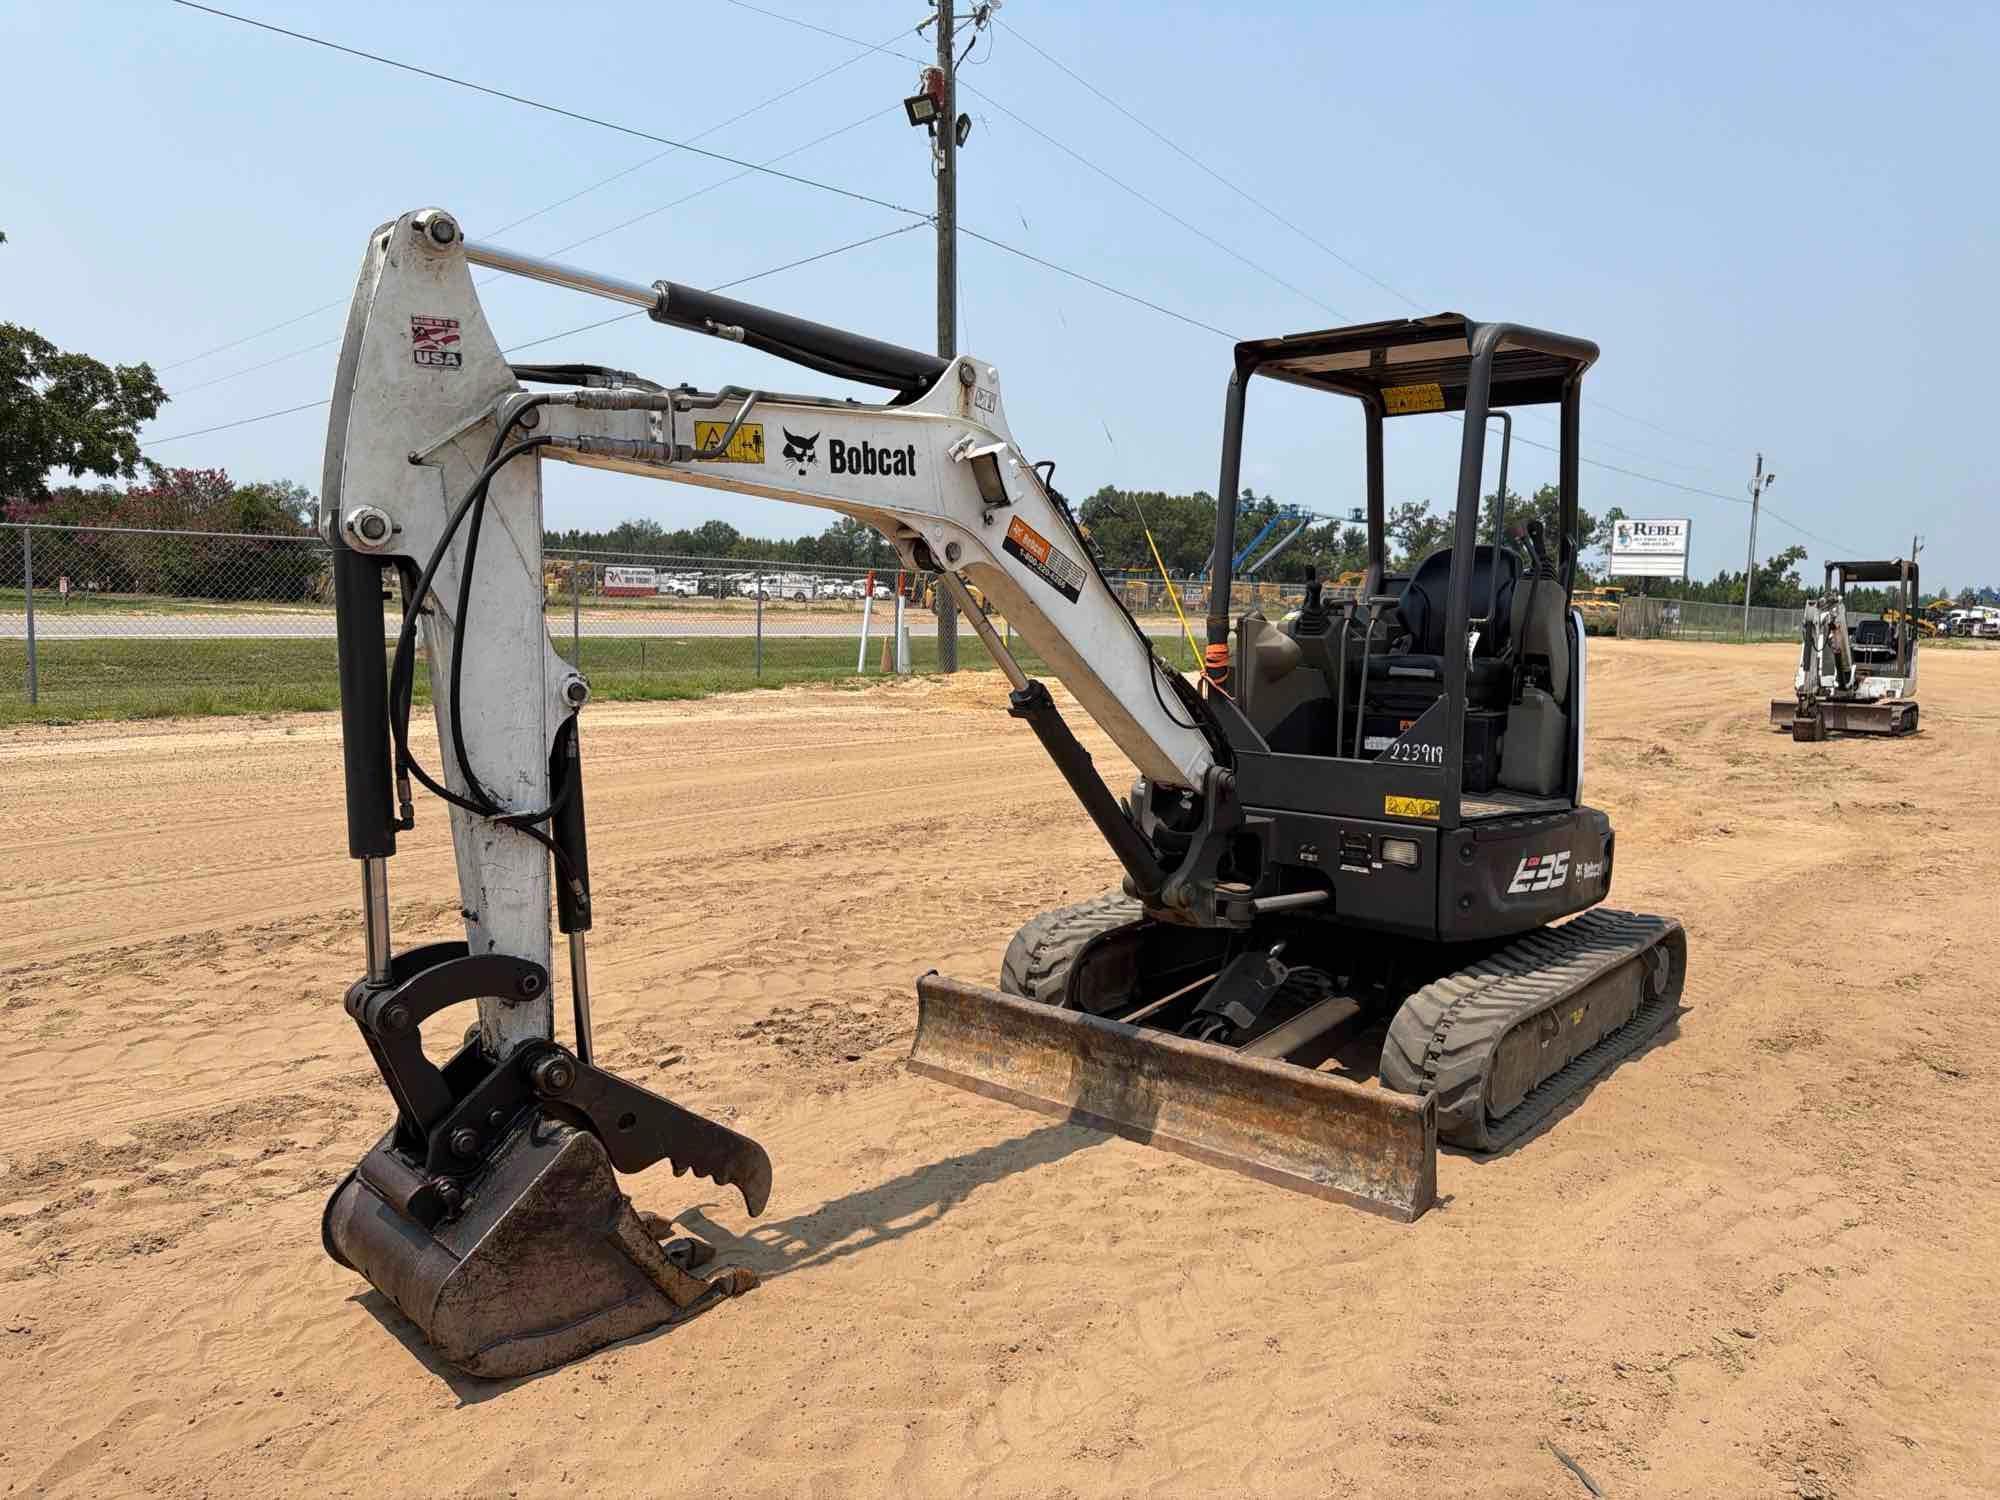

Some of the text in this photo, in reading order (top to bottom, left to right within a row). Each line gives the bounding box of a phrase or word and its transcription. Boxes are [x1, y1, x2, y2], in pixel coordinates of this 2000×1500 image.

[416, 351, 459, 365] USA
[829, 439, 916, 476] Bobcat
[1633, 522, 1683, 536] REBEL
[1390, 743, 1443, 763] 223919
[1507, 850, 1571, 893] E35
